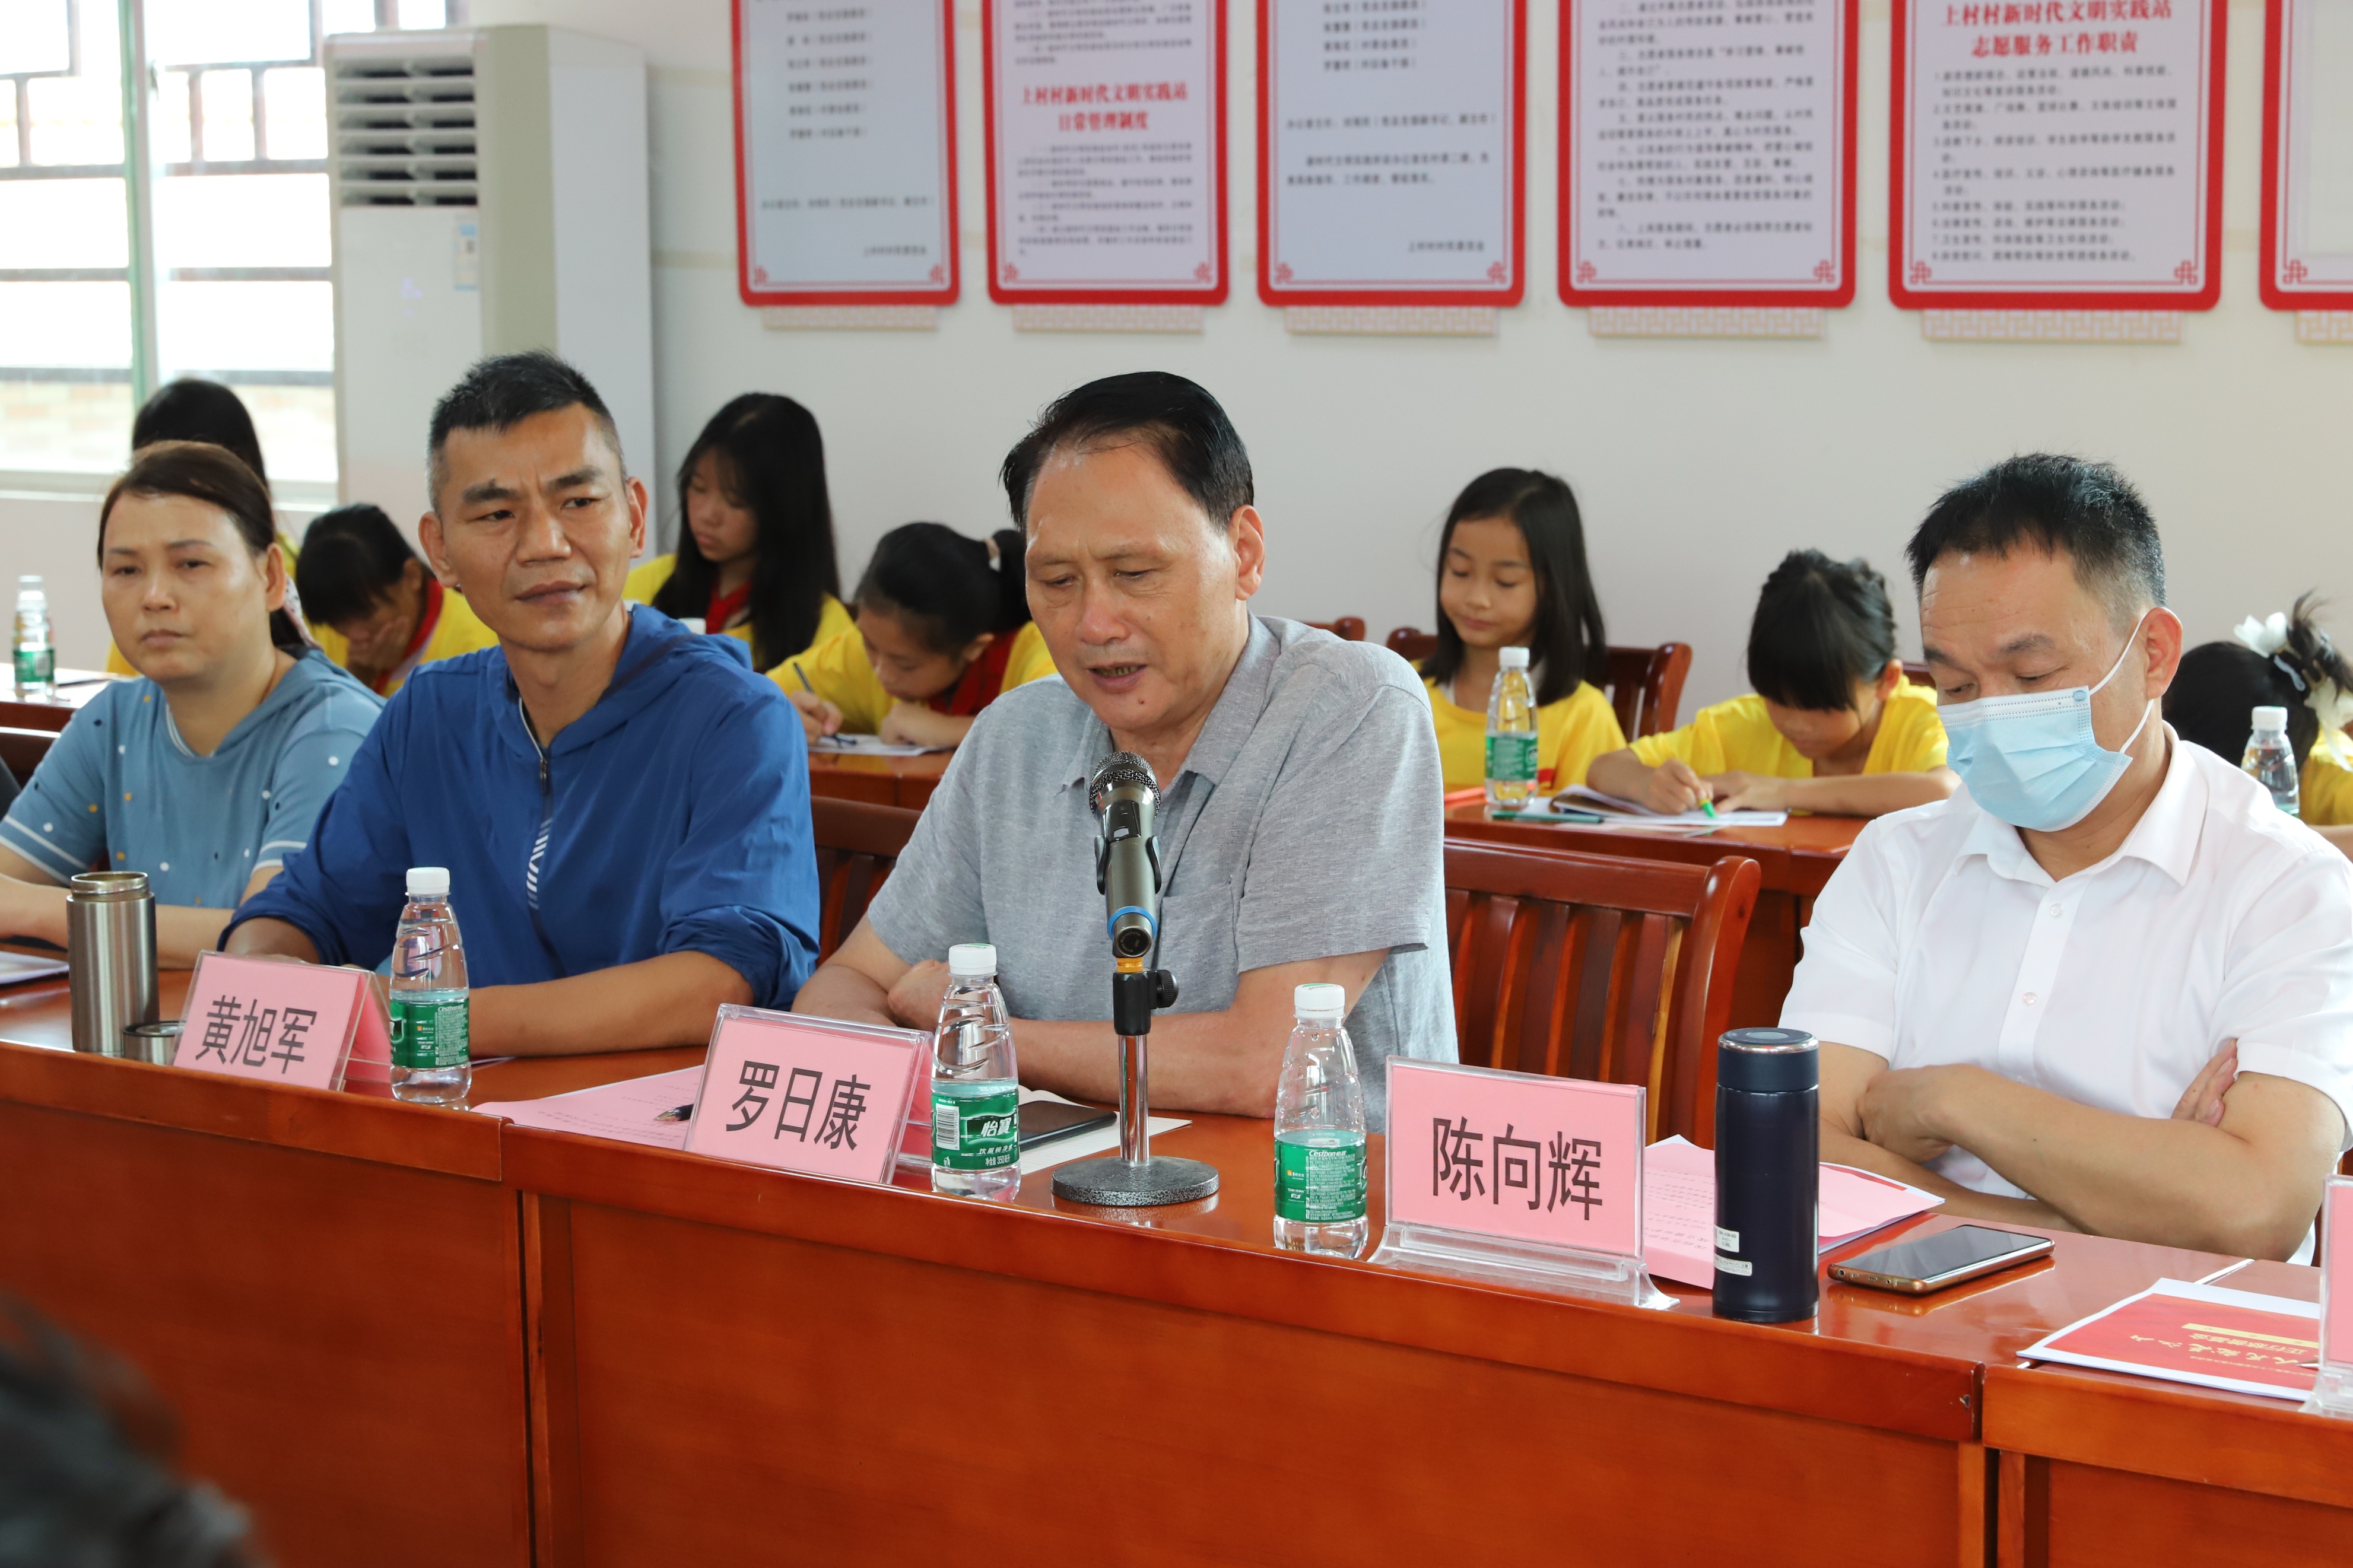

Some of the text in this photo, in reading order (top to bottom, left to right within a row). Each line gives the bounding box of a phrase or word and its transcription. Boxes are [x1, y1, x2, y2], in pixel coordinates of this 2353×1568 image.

[1971, 30, 2139, 58] 志愿服务工作职责
[1022, 82, 1188, 106] 上村村新时代文明实践站
[1058, 111, 1149, 131] 日常管理制度
[195, 994, 317, 1074] 黄旭军
[726, 1060, 871, 1151] 罗日康
[1433, 1116, 1603, 1221] 陈向辉
